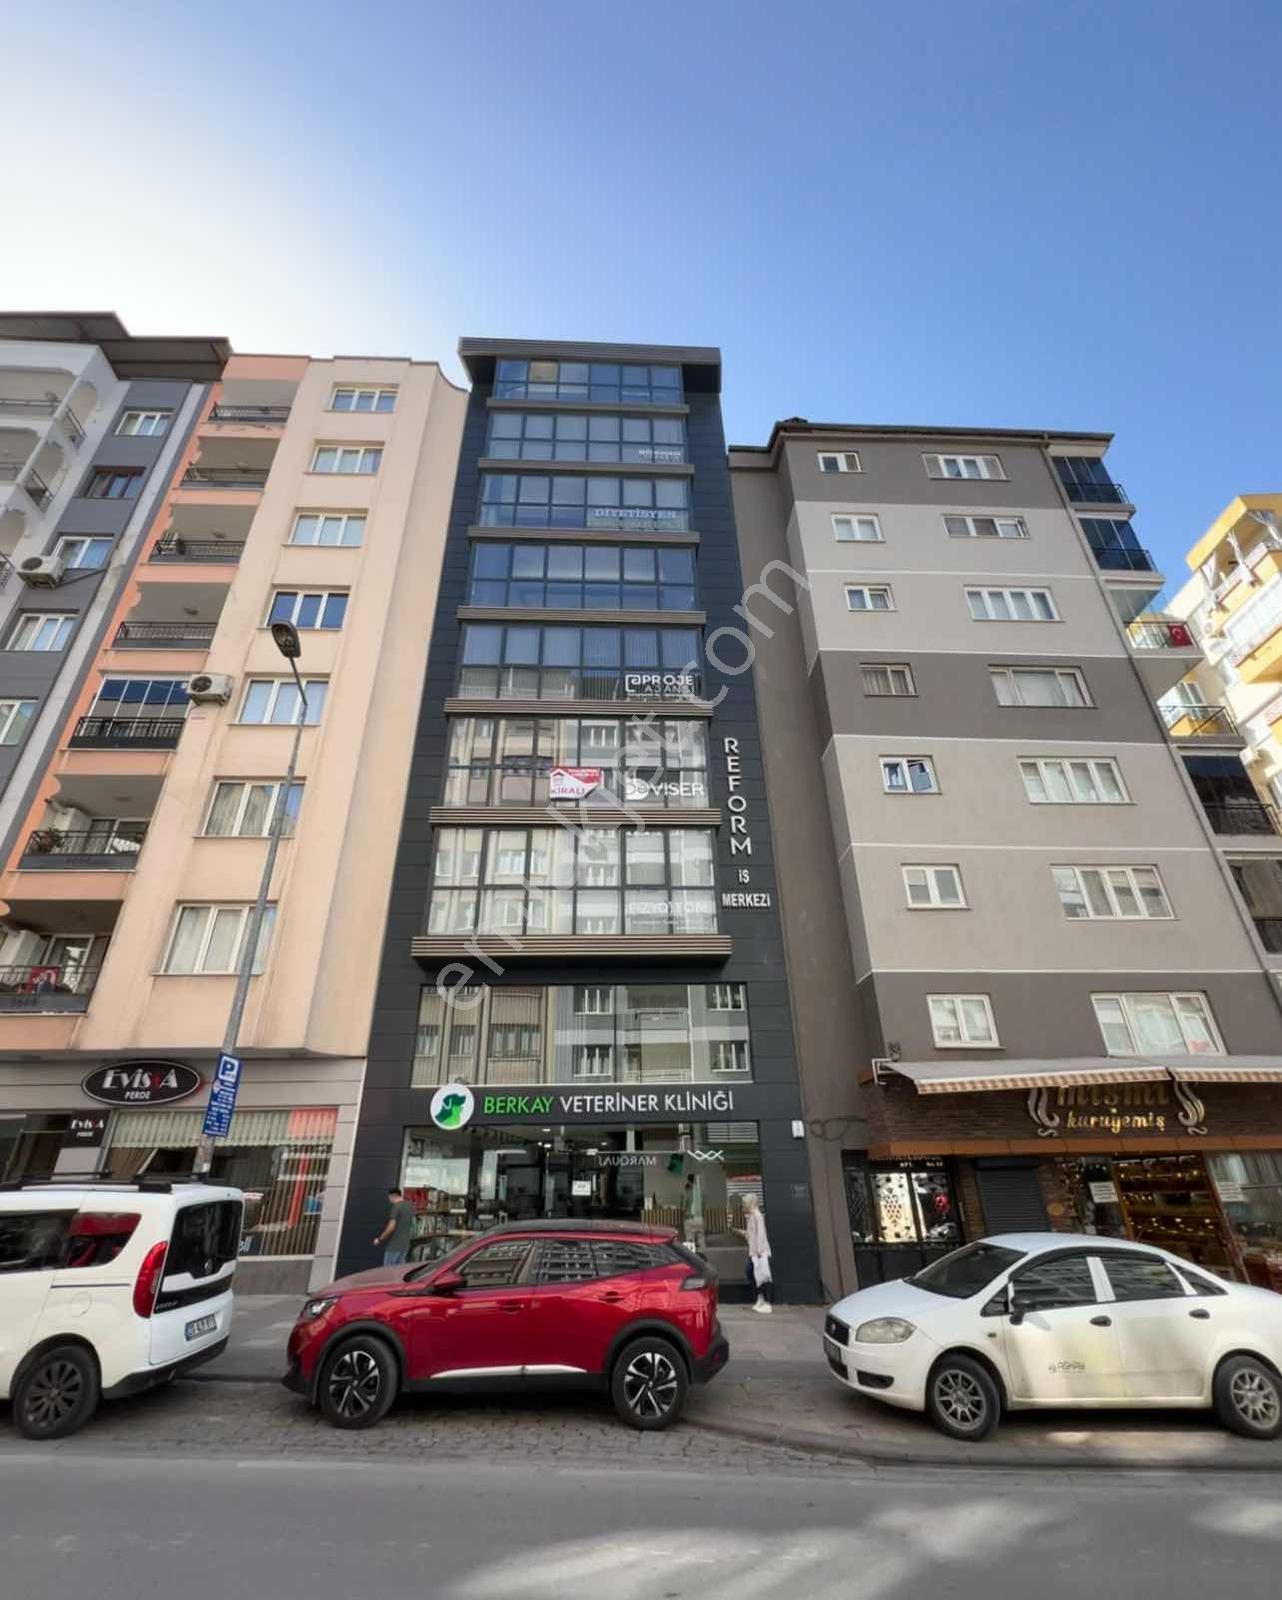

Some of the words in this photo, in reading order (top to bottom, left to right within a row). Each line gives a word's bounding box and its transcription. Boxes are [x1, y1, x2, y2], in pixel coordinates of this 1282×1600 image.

[642, 674, 694, 686] PROJE
[723, 737, 752, 855] REFORM
[221, 1059, 236, 1076] P
[483, 1096, 554, 1114] BERKAY
[560, 1092, 660, 1112] VETERİNER
[664, 1090, 734, 1112] KLİNİĞİ
[1066, 1110, 1166, 1134] kuruyemiş
